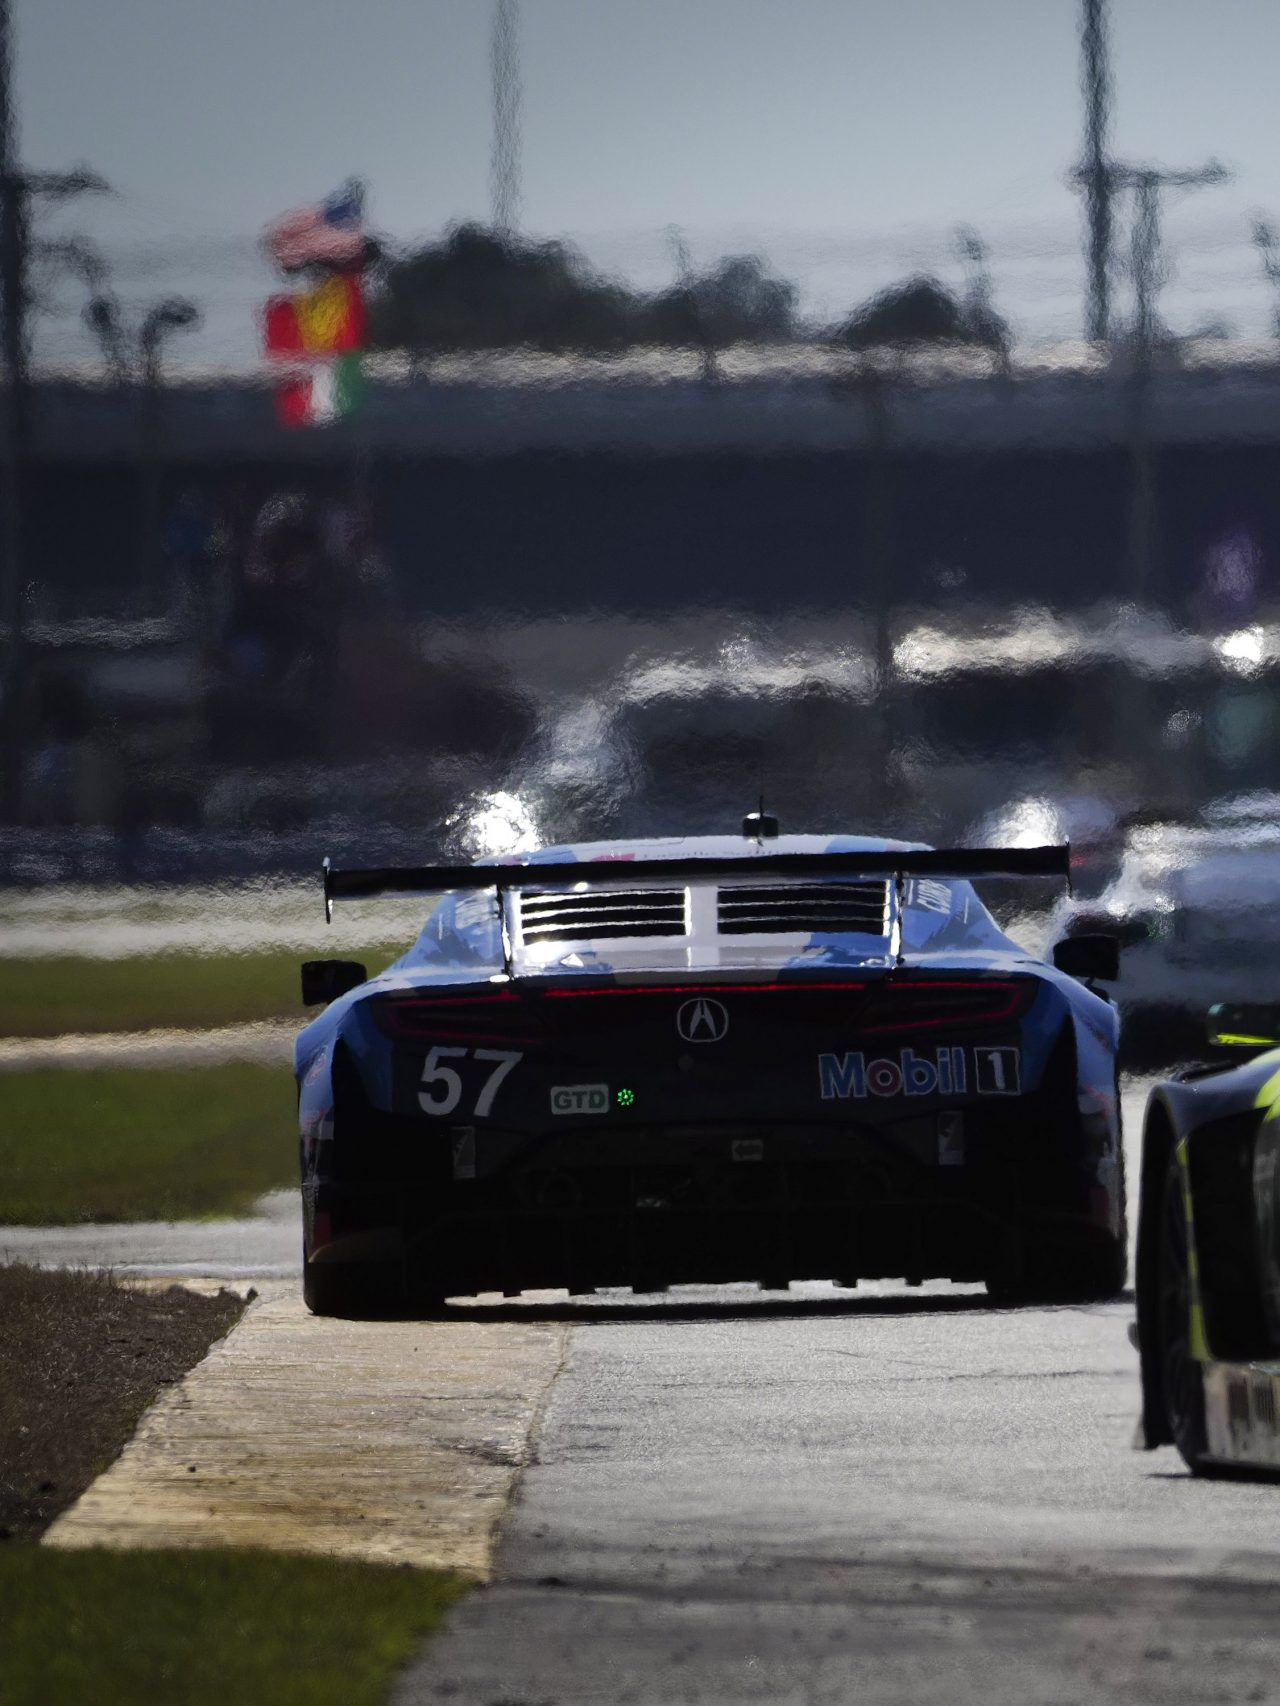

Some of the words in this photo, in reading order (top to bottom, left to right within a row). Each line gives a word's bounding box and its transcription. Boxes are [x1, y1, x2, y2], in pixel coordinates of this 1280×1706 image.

[417, 1046, 524, 1117] 57
[817, 1046, 967, 1099] Mobil
[553, 1090, 606, 1110] GTD
